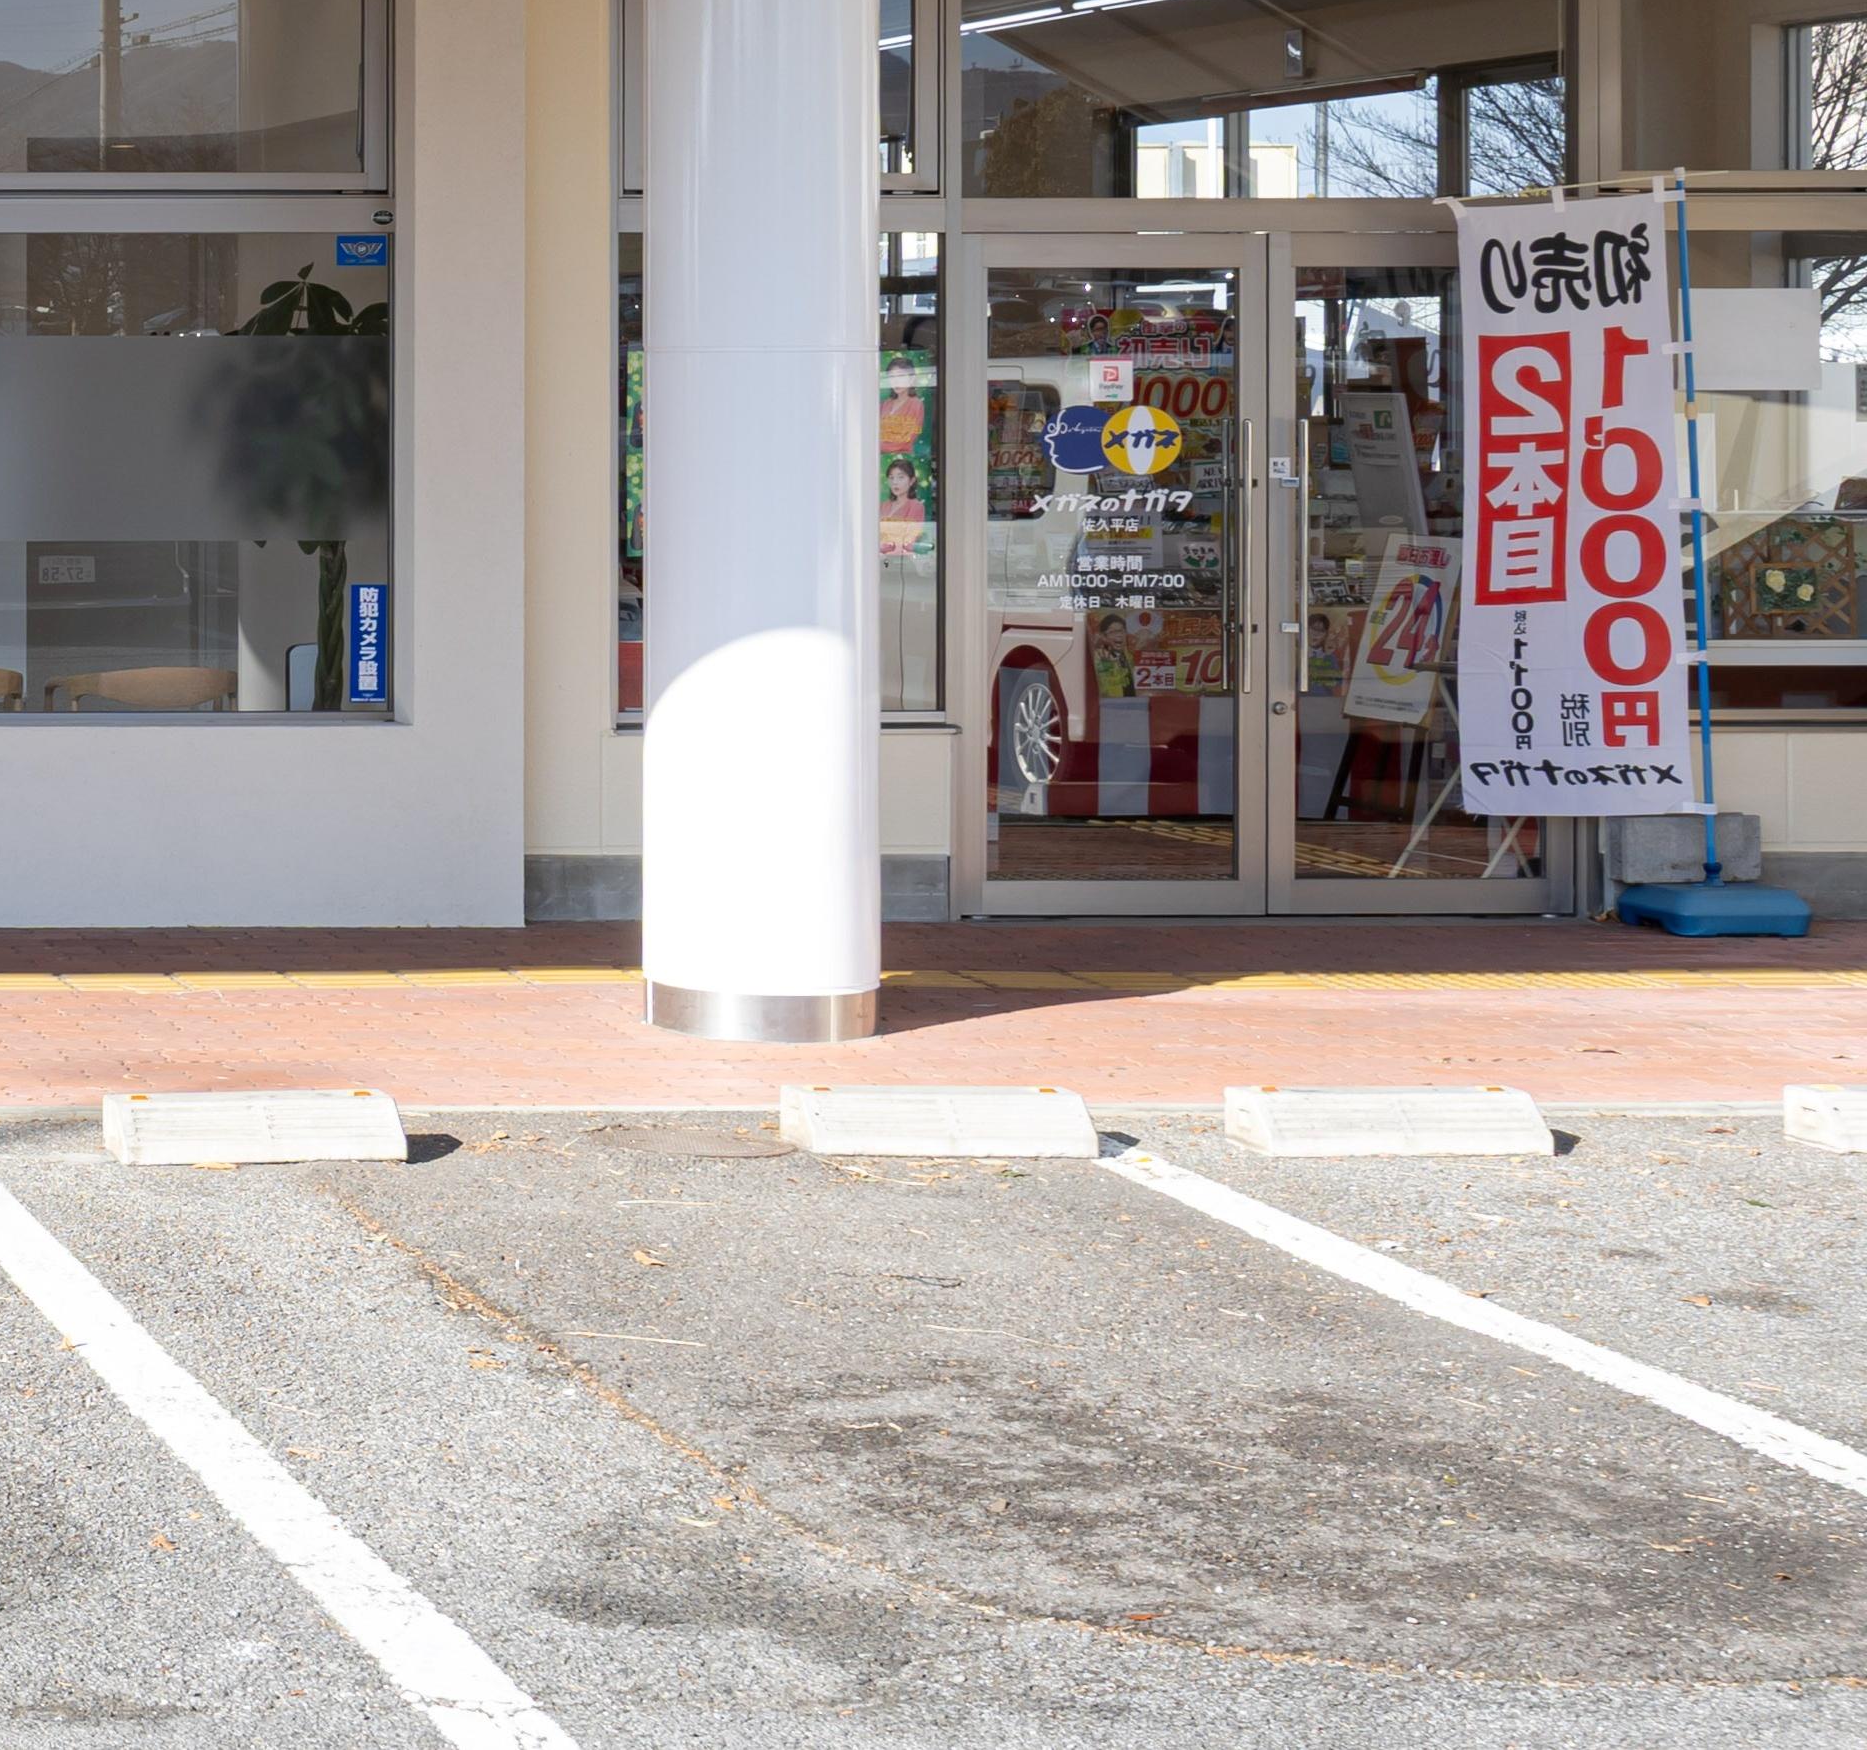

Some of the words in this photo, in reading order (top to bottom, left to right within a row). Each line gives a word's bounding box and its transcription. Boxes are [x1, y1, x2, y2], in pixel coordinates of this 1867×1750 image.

[1117, 336, 1212, 369] 初売り
[1103, 428, 1180, 449] メガネ
[1029, 488, 1194, 513] メガネのナガタ
[1081, 517, 1140, 533] 佐久平店
[1076, 555, 1143, 572] 営業時間
[1037, 574, 1186, 589] AM10:00~PM7:00
[1059, 595, 1101, 610] 定休日
[1114, 595, 1157, 610] 木曜日
[358, 586, 380, 691] 防犯カメラ設置
[1135, 667, 1176, 688] 2本目
